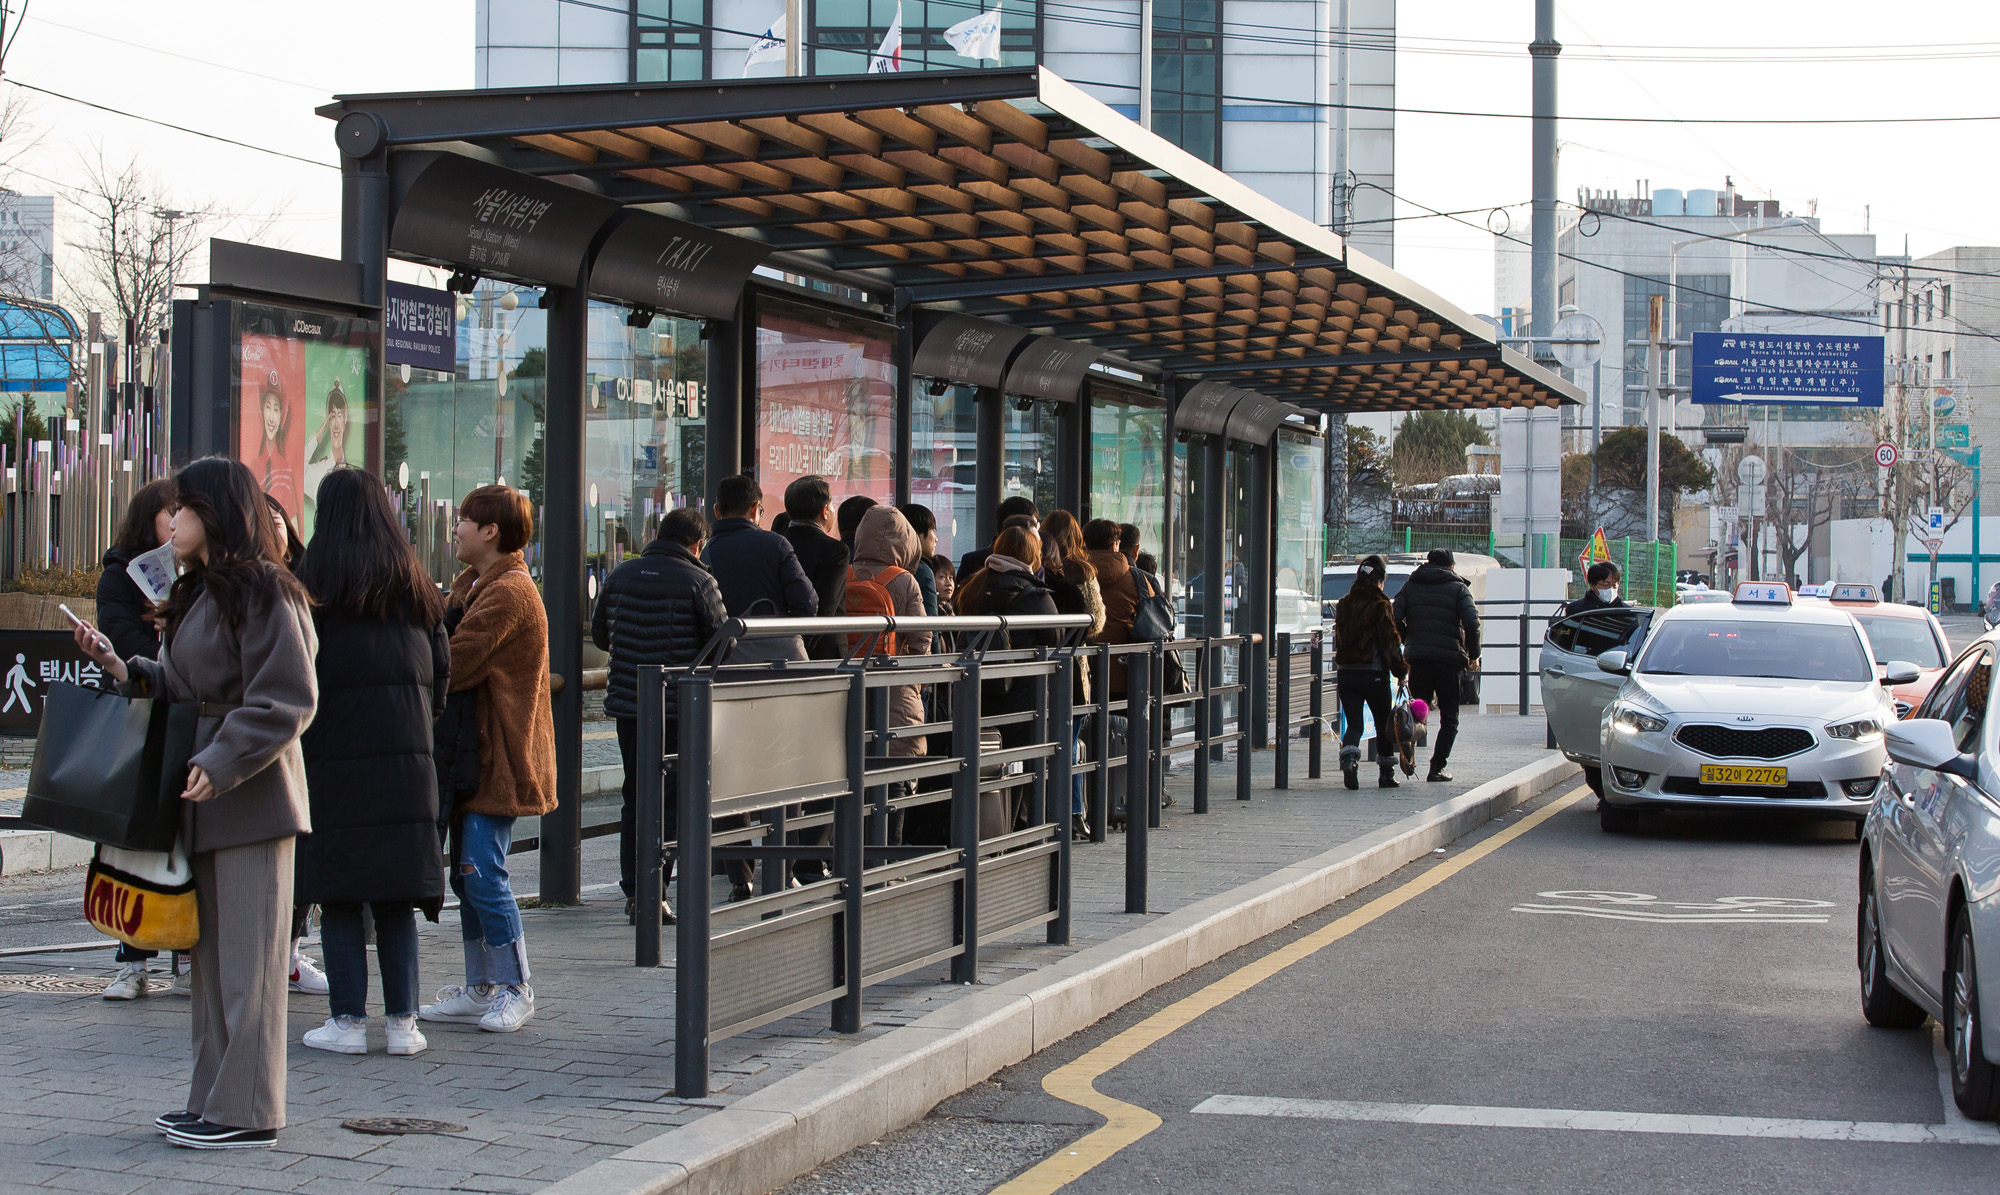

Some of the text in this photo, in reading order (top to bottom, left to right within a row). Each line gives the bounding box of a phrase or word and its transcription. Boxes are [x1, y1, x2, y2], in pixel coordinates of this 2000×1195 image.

[473, 187, 553, 233] 서울(서부)역
[467, 225, 483, 240] Seoul
[483, 227, 503, 246] Station
[657, 236, 713, 272] TAXI
[657, 275, 680, 298] 택시승차
[293, 319, 322, 335] JCDecaux
[395, 339, 413, 350] REGIONAL
[413, 342, 428, 352] RAILWAY
[428, 345, 441, 354] POLICE
[1714, 358, 1739, 366] KORAIL
[1713, 376, 1739, 384] KORAIL
[654, 378, 686, 414] 서울역
[689, 385, 697, 413] P
[1880, 449, 1891, 461] 60
[1748, 589, 1777, 600] 서울
[1842, 588, 1867, 597] 서울
[40, 659, 104, 688] 택시승
[1716, 767, 1742, 781] 32아
[1745, 768, 1781, 783] 2276
[90, 878, 144, 937] MIU
